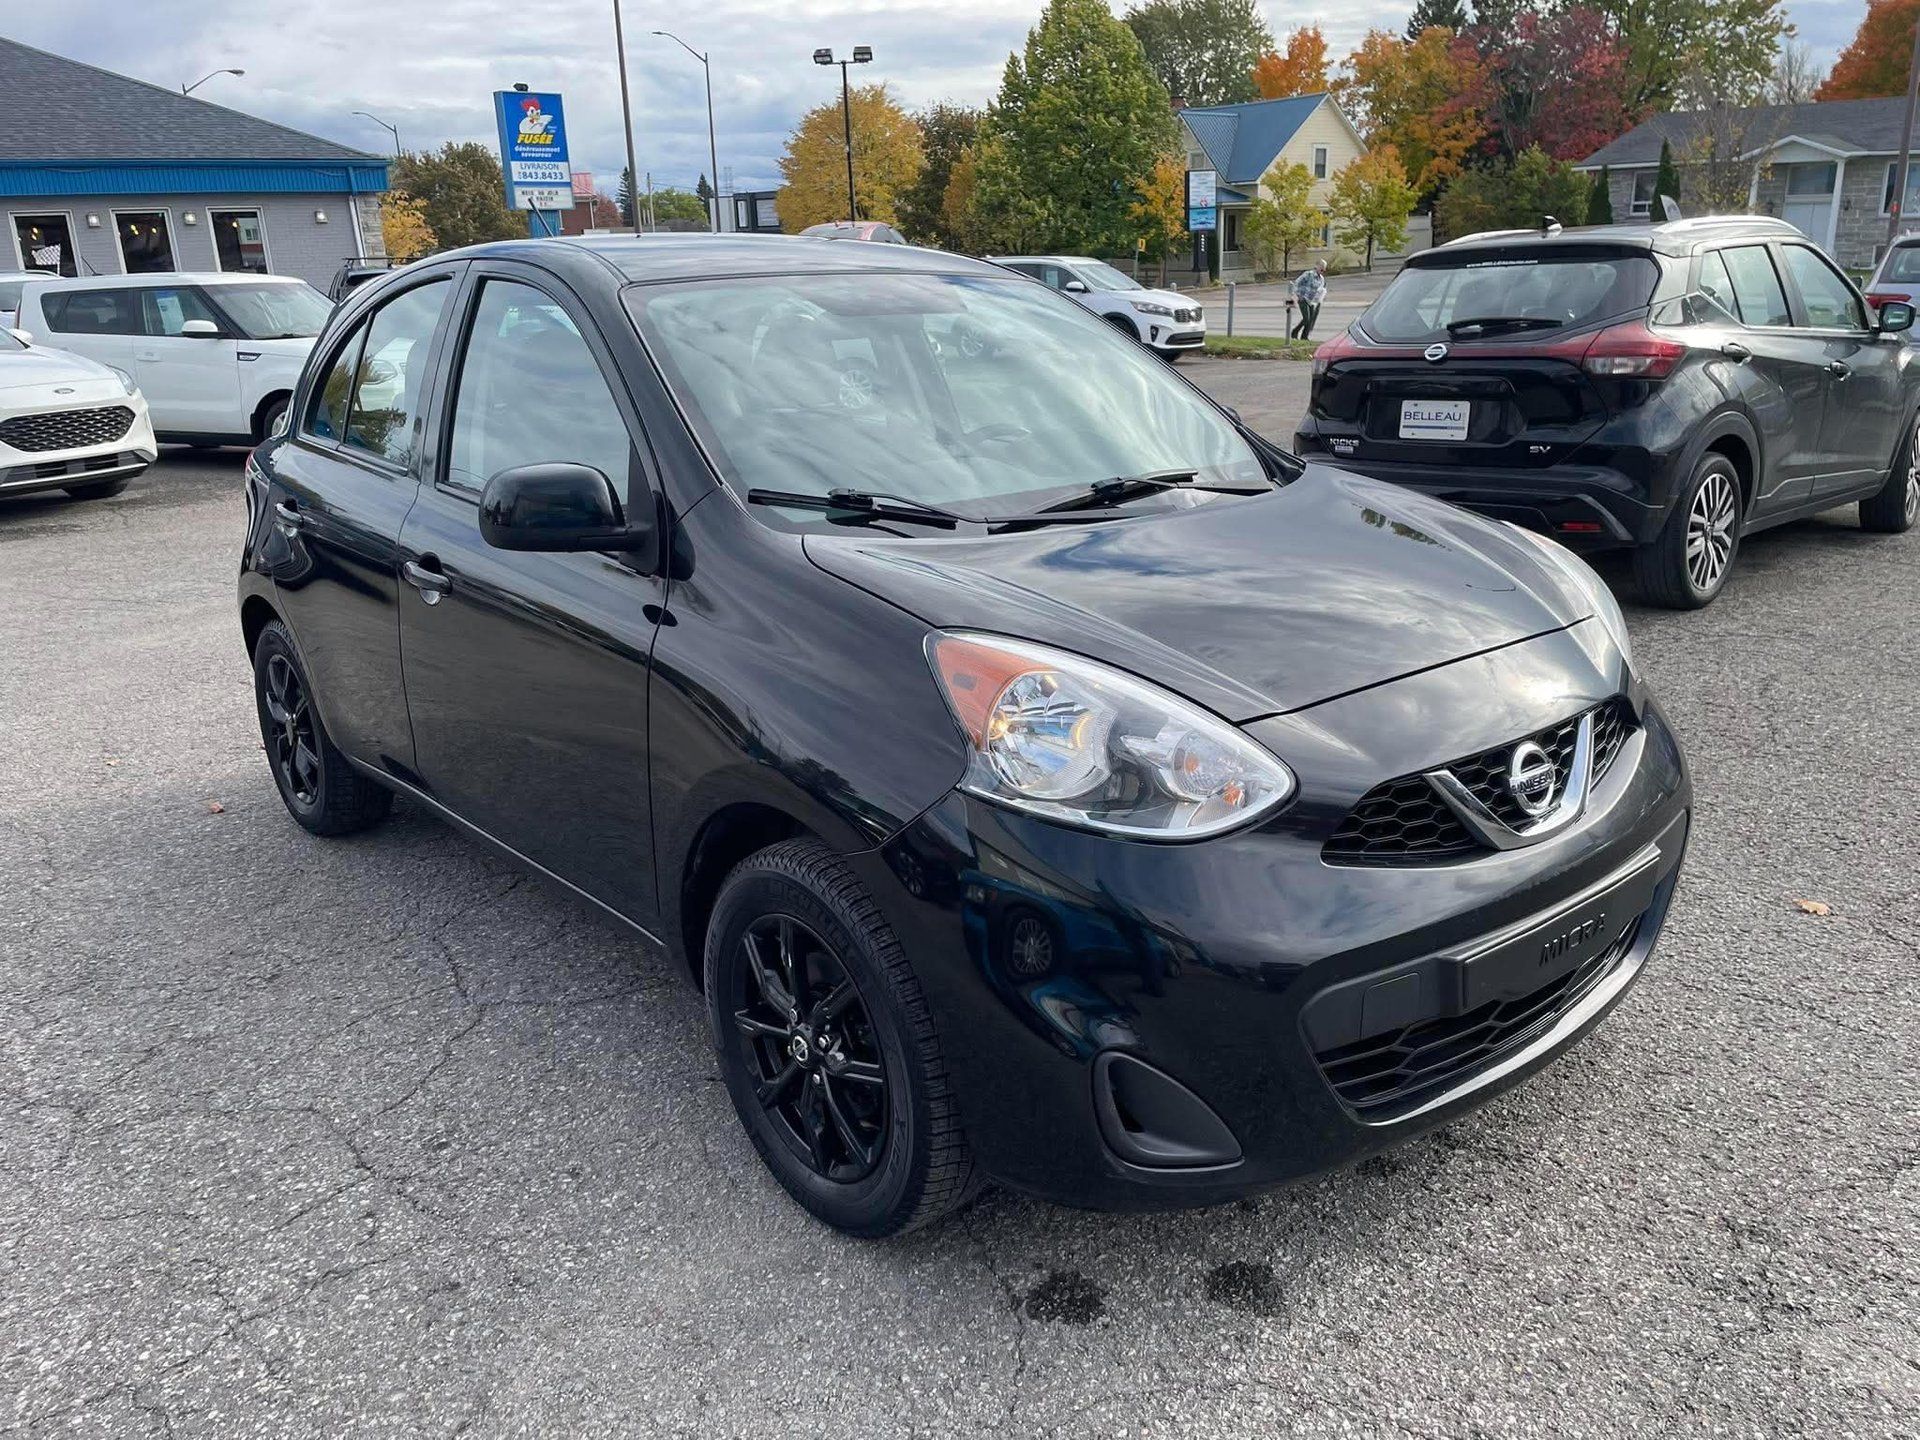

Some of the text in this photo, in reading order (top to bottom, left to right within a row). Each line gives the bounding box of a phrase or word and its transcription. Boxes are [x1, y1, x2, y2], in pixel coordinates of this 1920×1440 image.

[517, 132, 554, 144] FUSÉE
[520, 163, 560, 171] LIVRAISON
[1404, 411, 1462, 421] BELLEAU
[1329, 438, 1360, 447] KICKS
[1529, 445, 1551, 453] SV
[1539, 914, 1605, 967] MICRA
